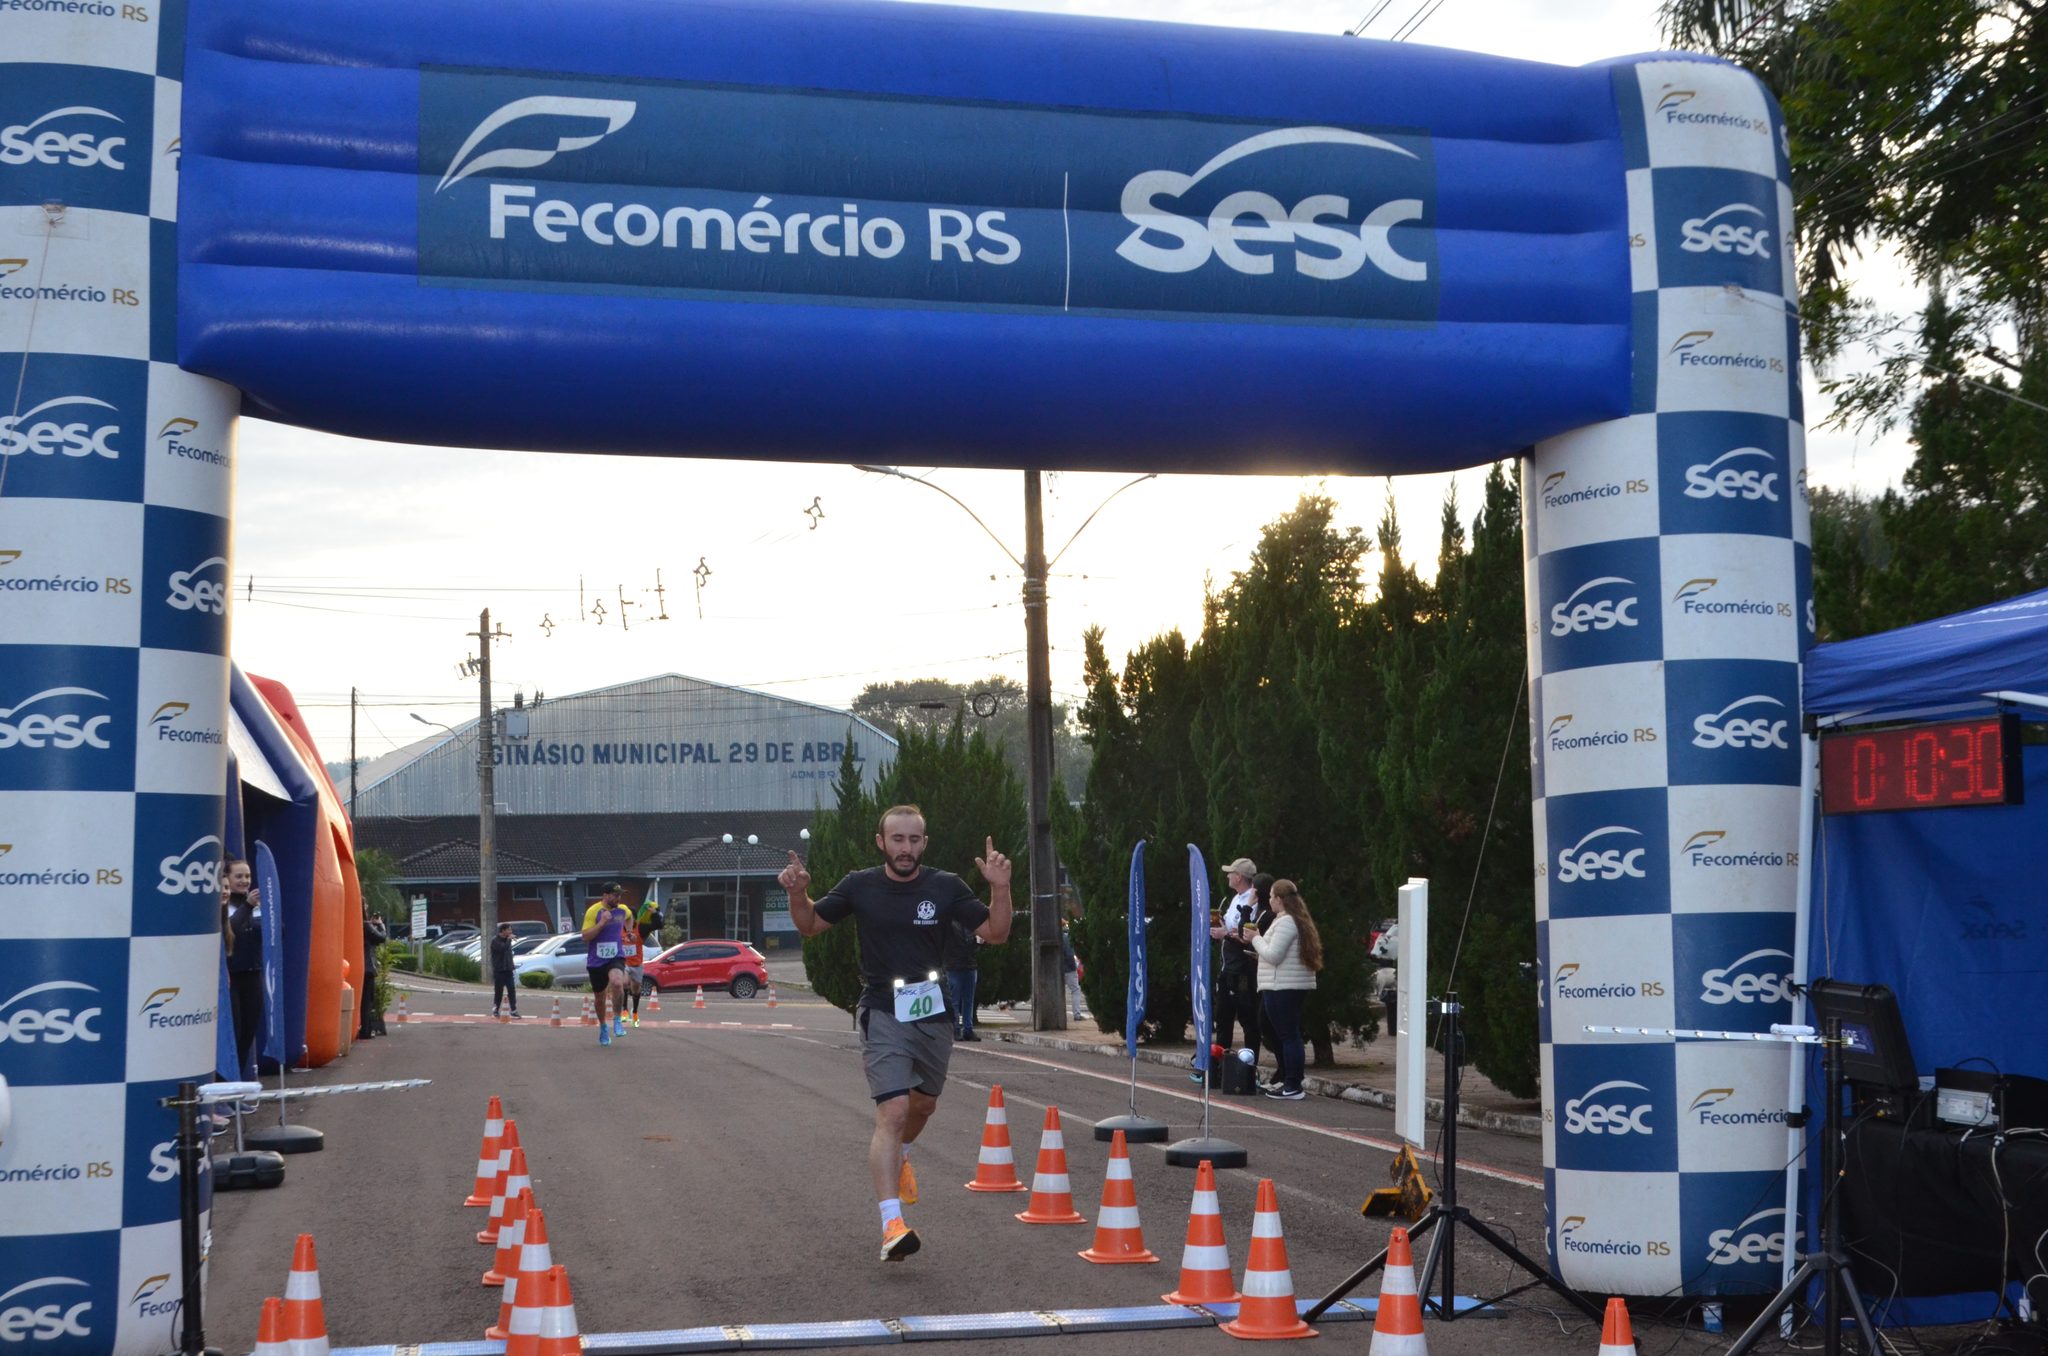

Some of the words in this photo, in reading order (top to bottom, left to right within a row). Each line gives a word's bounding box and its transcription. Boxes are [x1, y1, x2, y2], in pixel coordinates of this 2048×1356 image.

[122, 4, 149, 22] RS
[1667, 110, 1751, 130] Fecomércio
[1752, 119, 1768, 135] RS
[0, 125, 126, 170] Sesc
[489, 184, 905, 260] Fecomércio
[929, 207, 1021, 264] RS
[1115, 169, 1427, 282] Sesc
[1680, 217, 1771, 260] Sesc
[0, 283, 106, 303] ecomércio
[112, 288, 140, 306] RS
[1680, 353, 1766, 370] Fecomércio
[1769, 357, 1784, 373] RS
[0, 415, 120, 459] Sesc
[1544, 484, 1621, 509] Fecomércio
[1625, 479, 1649, 495] RS
[1683, 463, 1779, 502] Sesc
[0, 574, 99, 594] ecomércio
[105, 577, 132, 595] RS
[165, 570, 232, 616] Ses
[1550, 597, 1639, 637] Sesc
[1684, 600, 1773, 616] Fecomércio
[1777, 602, 1792, 618] RS
[159, 724, 223, 746] Fecomércio
[1551, 731, 1628, 752] Fecomércio
[1633, 727, 1657, 743] RS
[1691, 714, 1789, 750] Sesc
[492, 739, 584, 765] GINÁSIO
[593, 743, 720, 764] MUNICIPAL
[729, 742, 758, 763] 29
[766, 742, 794, 763] DE
[802, 742, 866, 762] ABRL
[1558, 848, 1646, 883] Sesc
[1692, 851, 1783, 868] Fecomércio
[0, 868, 90, 886] comércio
[96, 868, 123, 885] RS
[600, 948, 615, 957] 124
[1559, 982, 1636, 999] Fecomércio
[1641, 982, 1664, 997] RS
[150, 1005, 213, 1028] Fecomércio
[909, 995, 933, 1017] 40
[1564, 1098, 1653, 1135] Sesc
[0, 1164, 80, 1182] omércio
[86, 1162, 113, 1178] RS
[1564, 1236, 1641, 1256] Fecomércio
[1647, 1241, 1671, 1256] RS
[0, 1301, 92, 1341] esc
